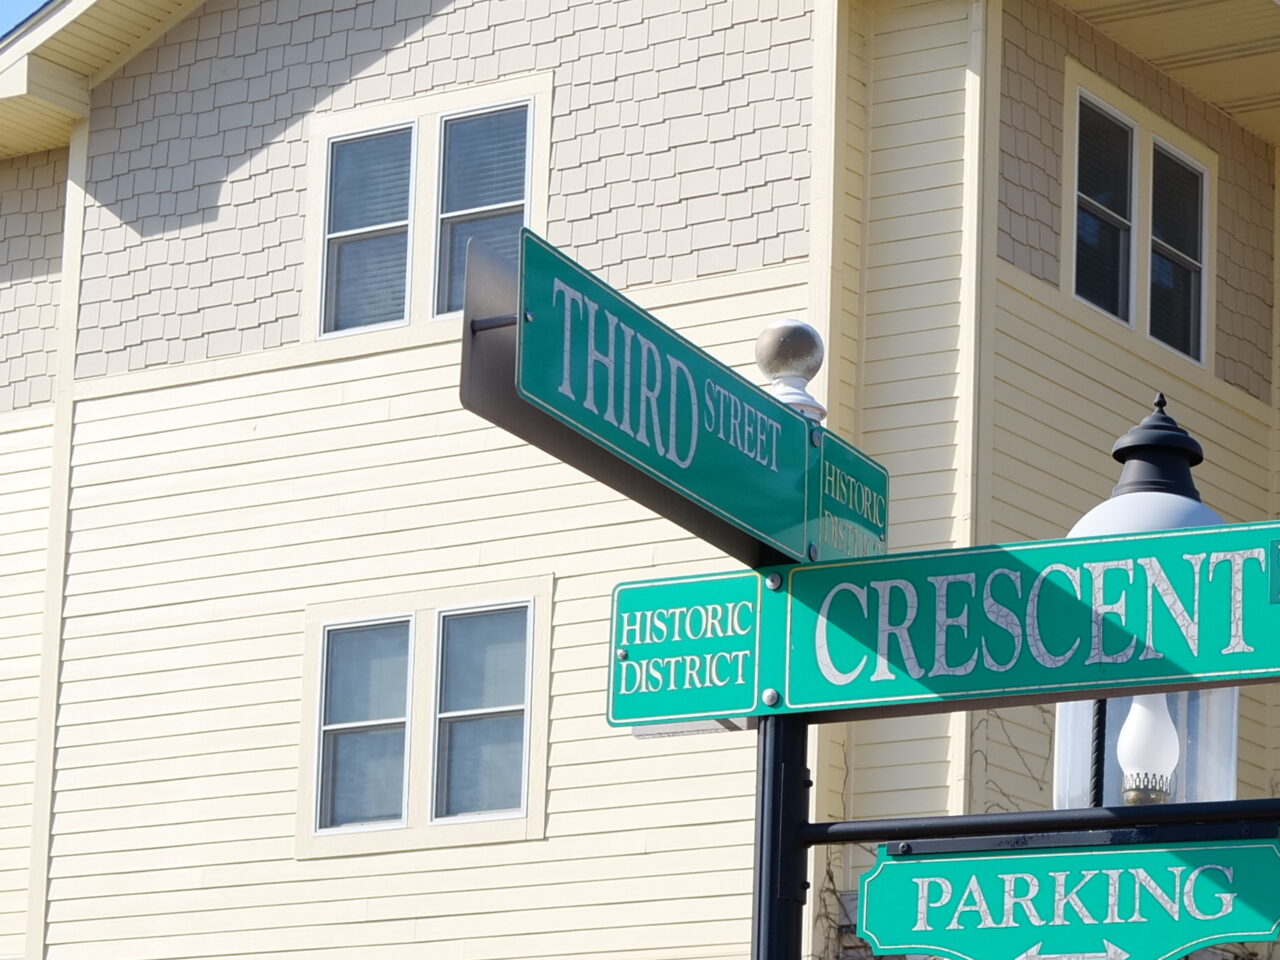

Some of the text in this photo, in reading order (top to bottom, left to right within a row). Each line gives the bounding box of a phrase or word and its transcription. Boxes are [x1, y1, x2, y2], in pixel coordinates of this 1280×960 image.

[553, 278, 782, 472] THIRD STREET
[824, 458, 885, 528] HISTORIC
[620, 599, 753, 648] HISTORIC
[815, 547, 1266, 686] CRESCENT
[619, 648, 751, 696] DISTRICT
[911, 863, 1238, 932] PARKING
